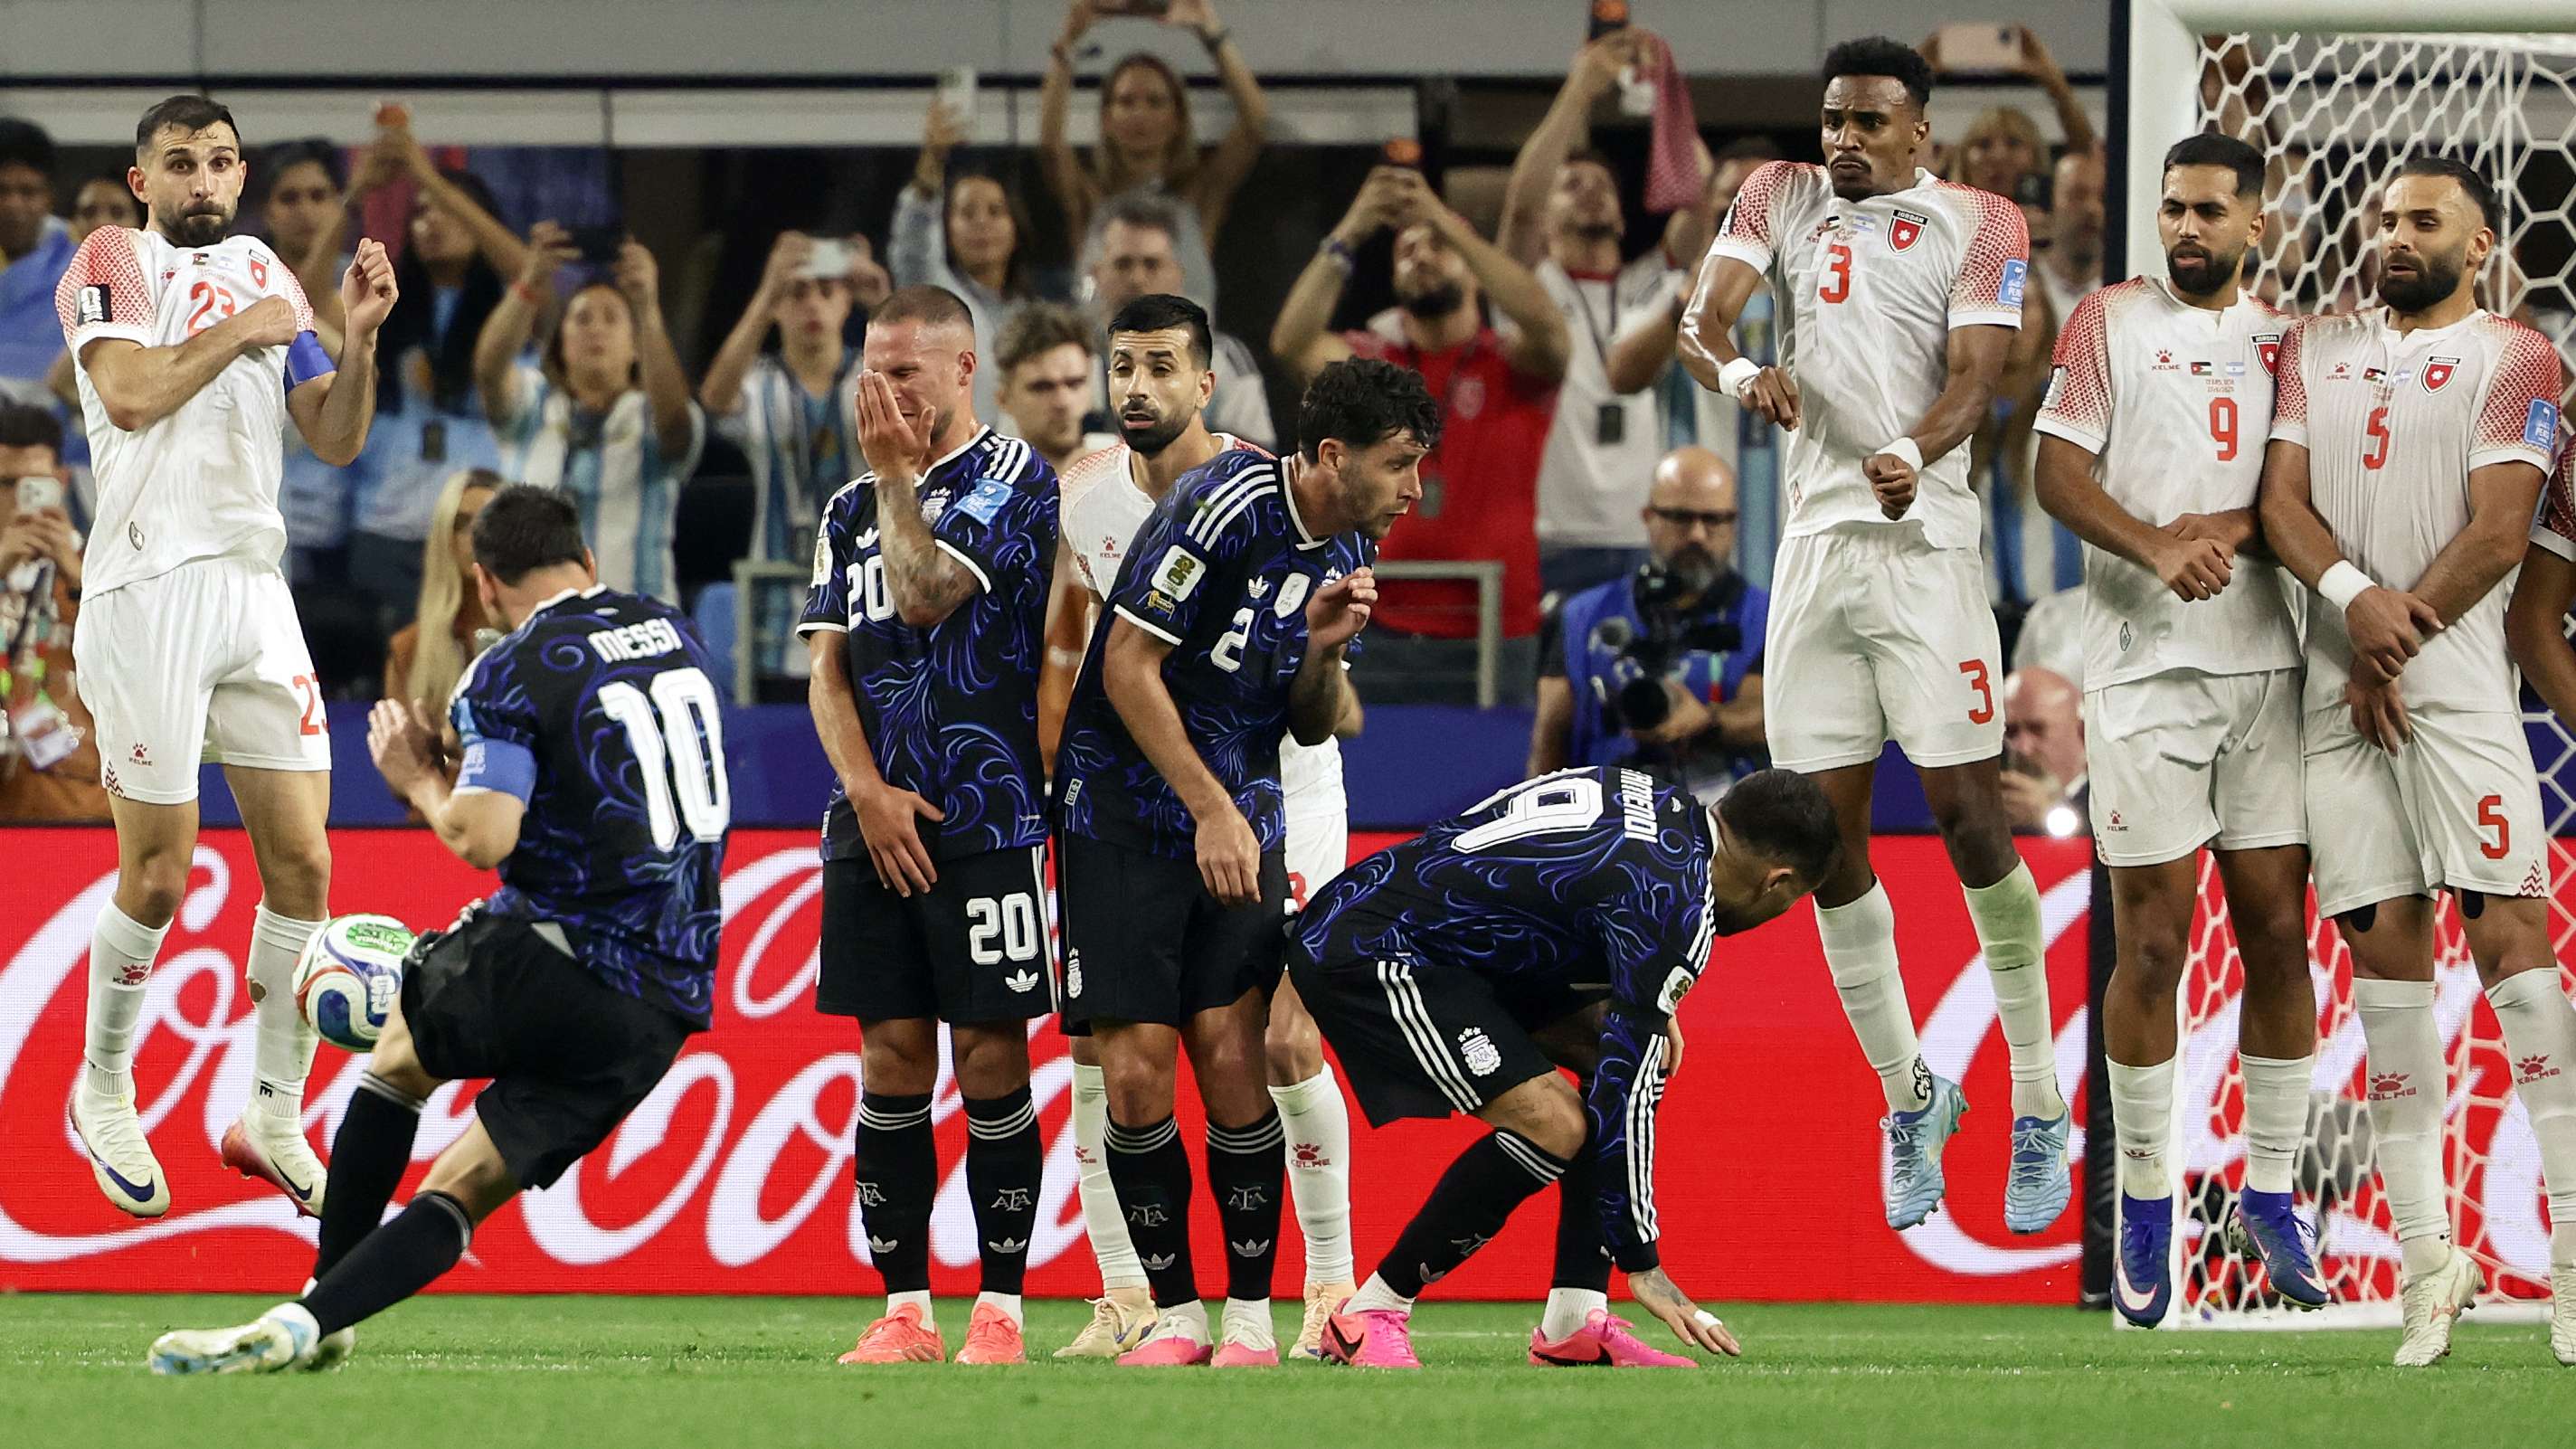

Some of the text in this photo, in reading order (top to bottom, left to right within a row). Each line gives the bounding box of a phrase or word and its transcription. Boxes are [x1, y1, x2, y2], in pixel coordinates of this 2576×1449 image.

[1819, 243, 1852, 304] 3
[2209, 396, 2239, 461] 9
[2362, 406, 2391, 470] 5
[846, 554, 897, 632] 20
[587, 617, 683, 664] MESSI
[1209, 606, 1255, 674] 2
[292, 671, 330, 736] 2
[1958, 658, 1995, 724] 3
[128, 756, 154, 767] KELME
[597, 666, 732, 853] 10
[2477, 794, 2511, 860] 5
[966, 892, 1039, 965] 20
[2516, 1067, 2562, 1085] KELME
